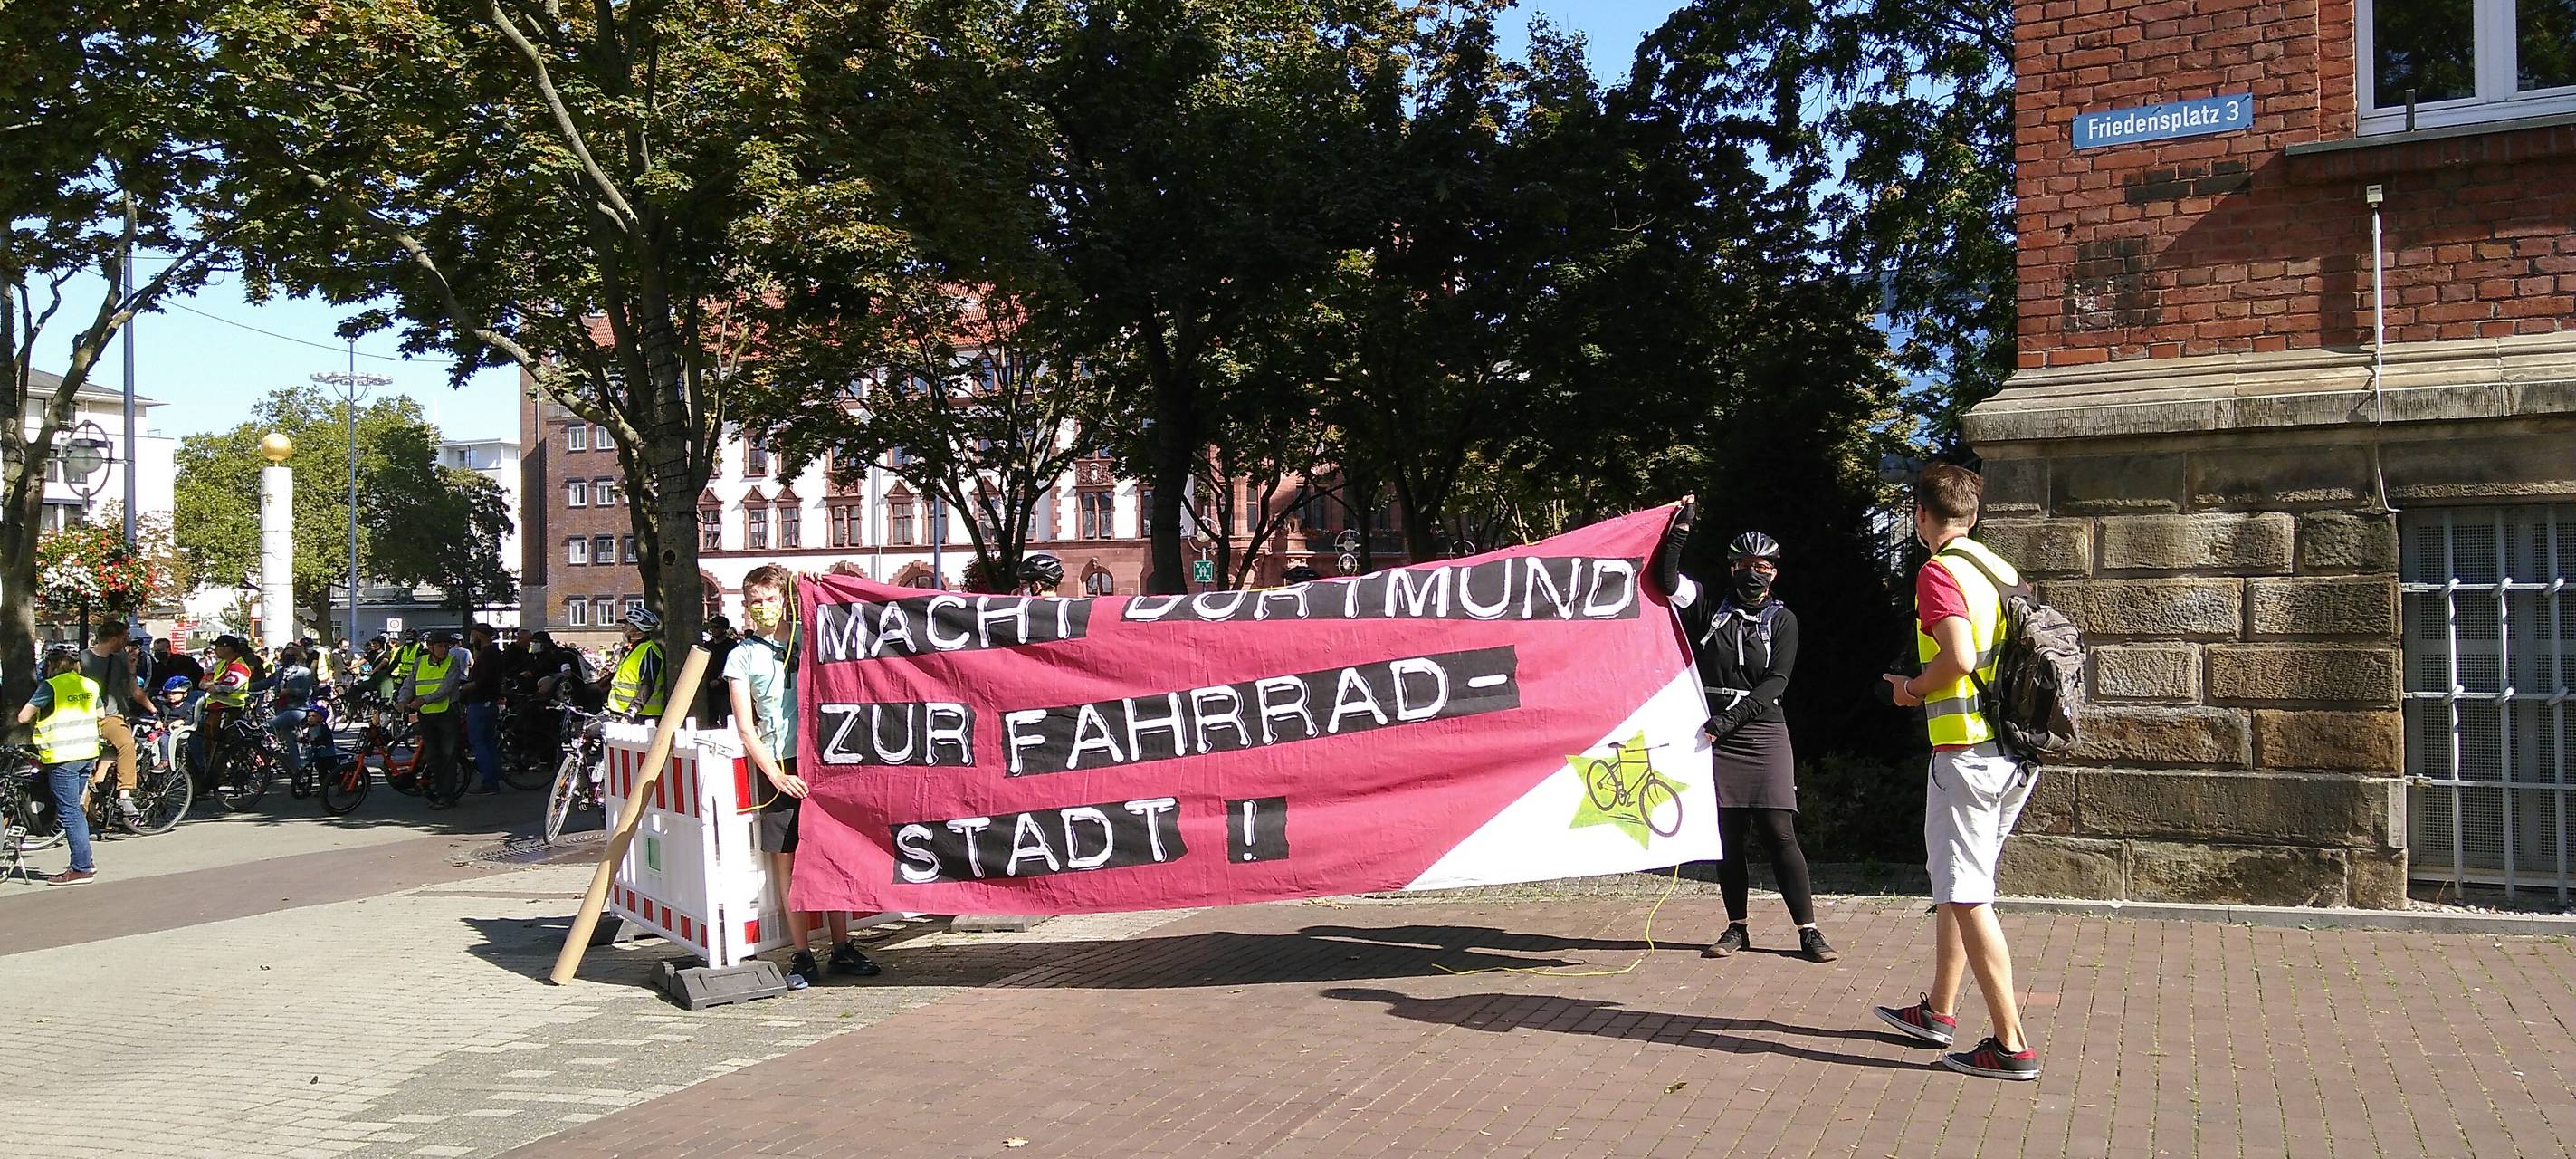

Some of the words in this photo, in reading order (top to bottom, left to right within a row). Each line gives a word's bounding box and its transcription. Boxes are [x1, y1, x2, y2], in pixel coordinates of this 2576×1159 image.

[2087, 106, 2220, 139] Friedensplatz
[2225, 101, 2240, 121] 3
[816, 595, 1089, 665] MACHT
[820, 703, 975, 767] ZUR
[895, 797, 1176, 884] STADT
[1242, 800, 1257, 861] !
